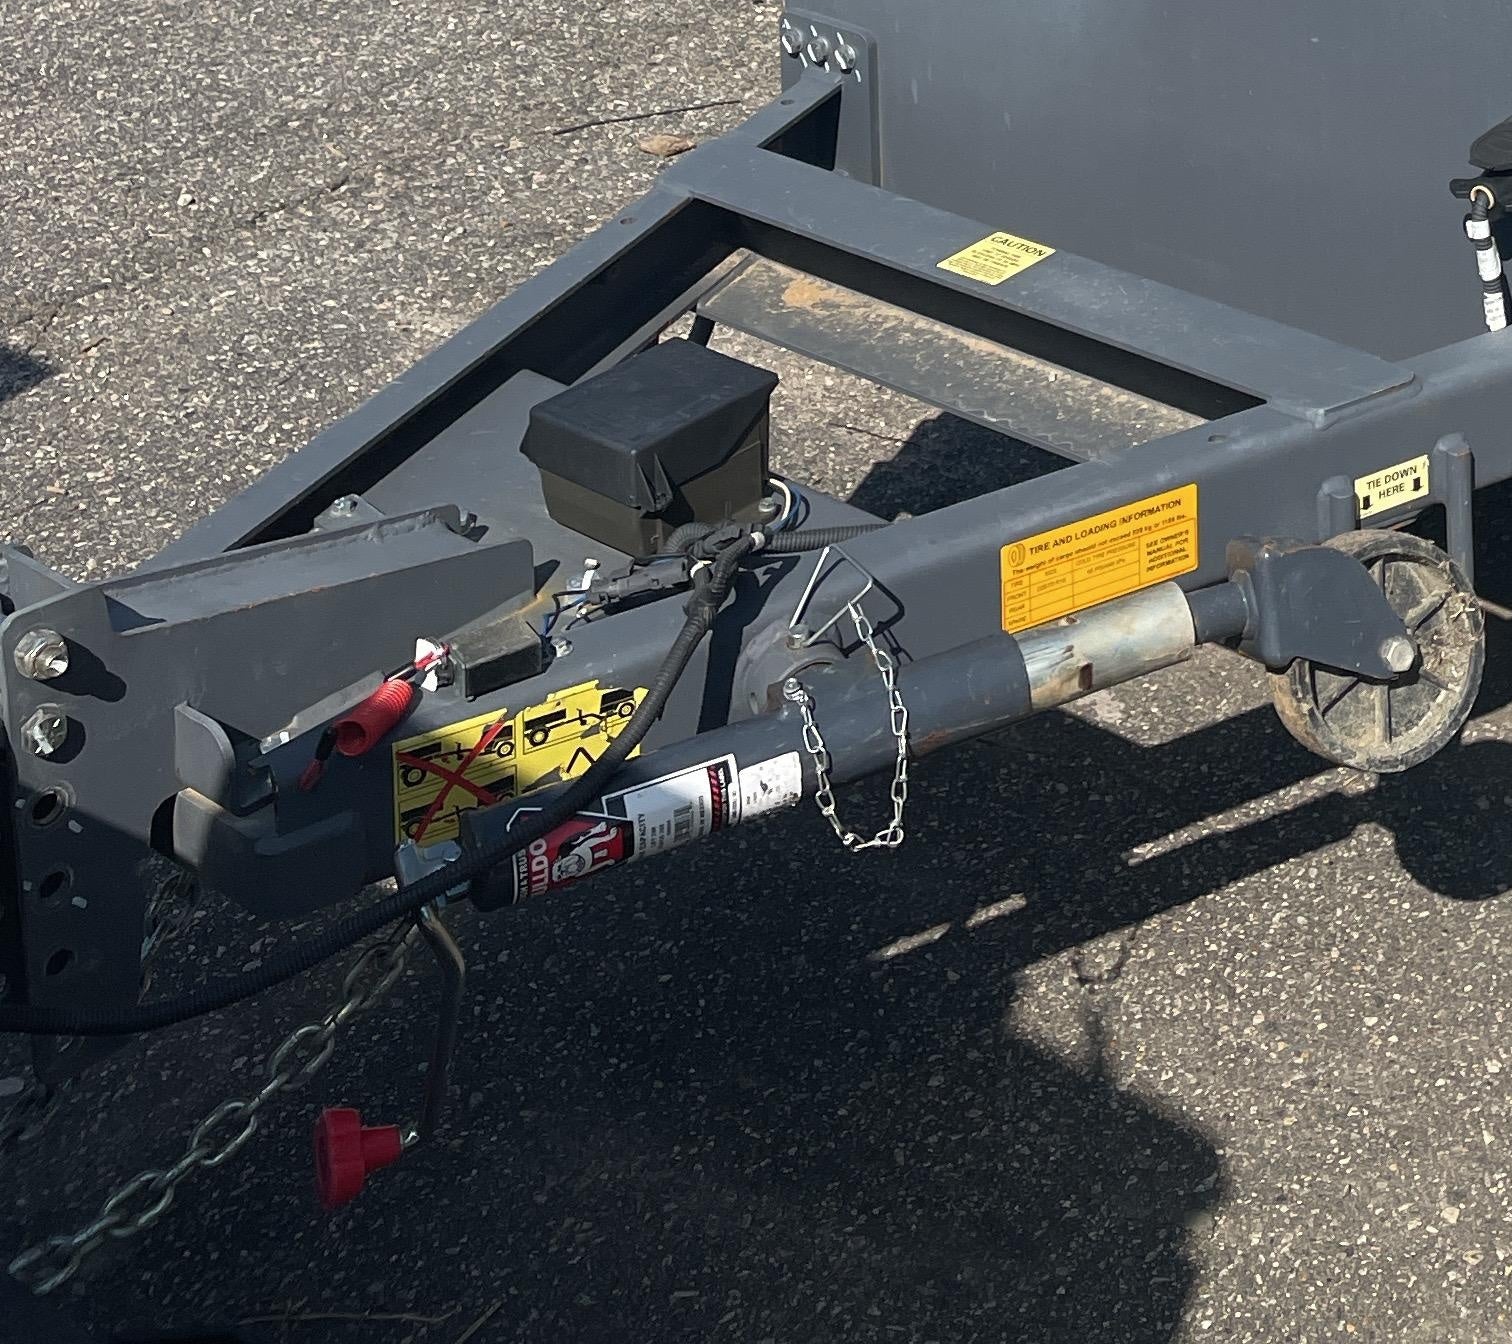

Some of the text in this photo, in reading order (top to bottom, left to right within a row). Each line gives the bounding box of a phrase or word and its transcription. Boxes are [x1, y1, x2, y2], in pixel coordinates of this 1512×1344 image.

[990, 236, 1047, 257] CAUTION
[1366, 465, 1417, 490] TIE DOWN
[1378, 482, 1405, 499] HERE
[1029, 498, 1182, 556] TIRE AND LOADING INFORMATION
[1056, 551, 1074, 561] cargo
[1074, 543, 1097, 554] should
[1109, 531, 1131, 543] exceed
[1146, 537, 1189, 556] MANUAL FOR
[518, 848, 529, 879] TRUS
[528, 838, 549, 896] ULLDO
